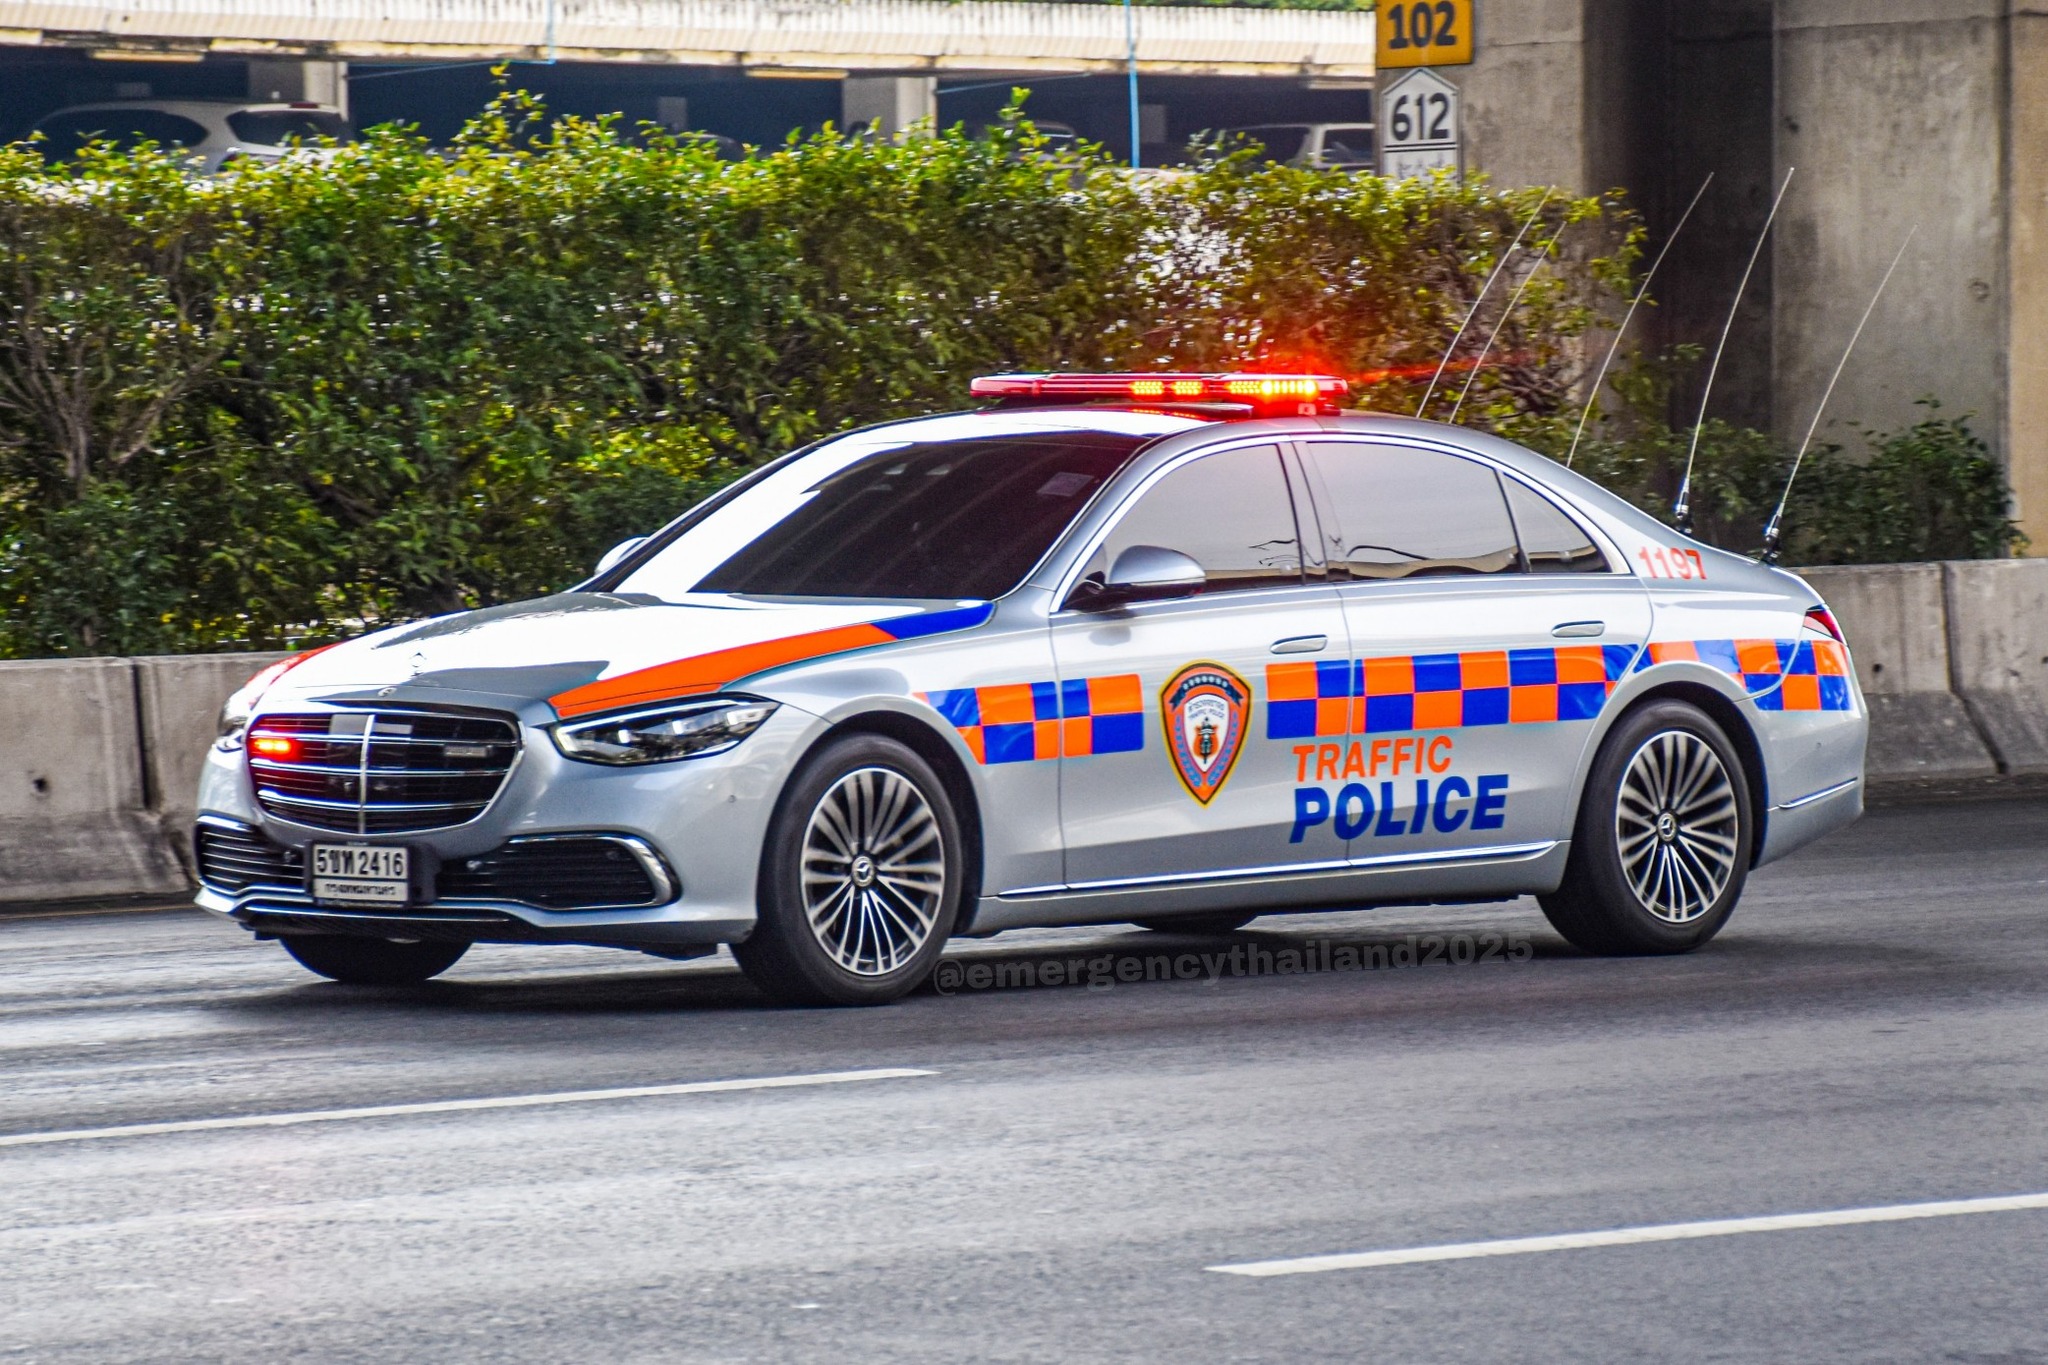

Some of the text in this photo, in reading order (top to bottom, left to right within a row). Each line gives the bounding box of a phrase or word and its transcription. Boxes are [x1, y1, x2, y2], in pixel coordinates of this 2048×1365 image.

[1387, 1, 1457, 49] 102
[1391, 92, 1450, 141] 612
[1639, 546, 1708, 580] 1197
[1292, 735, 1453, 782] TRAFFIC
[1289, 773, 1509, 844] POLICE
[359, 850, 404, 876] 2416
